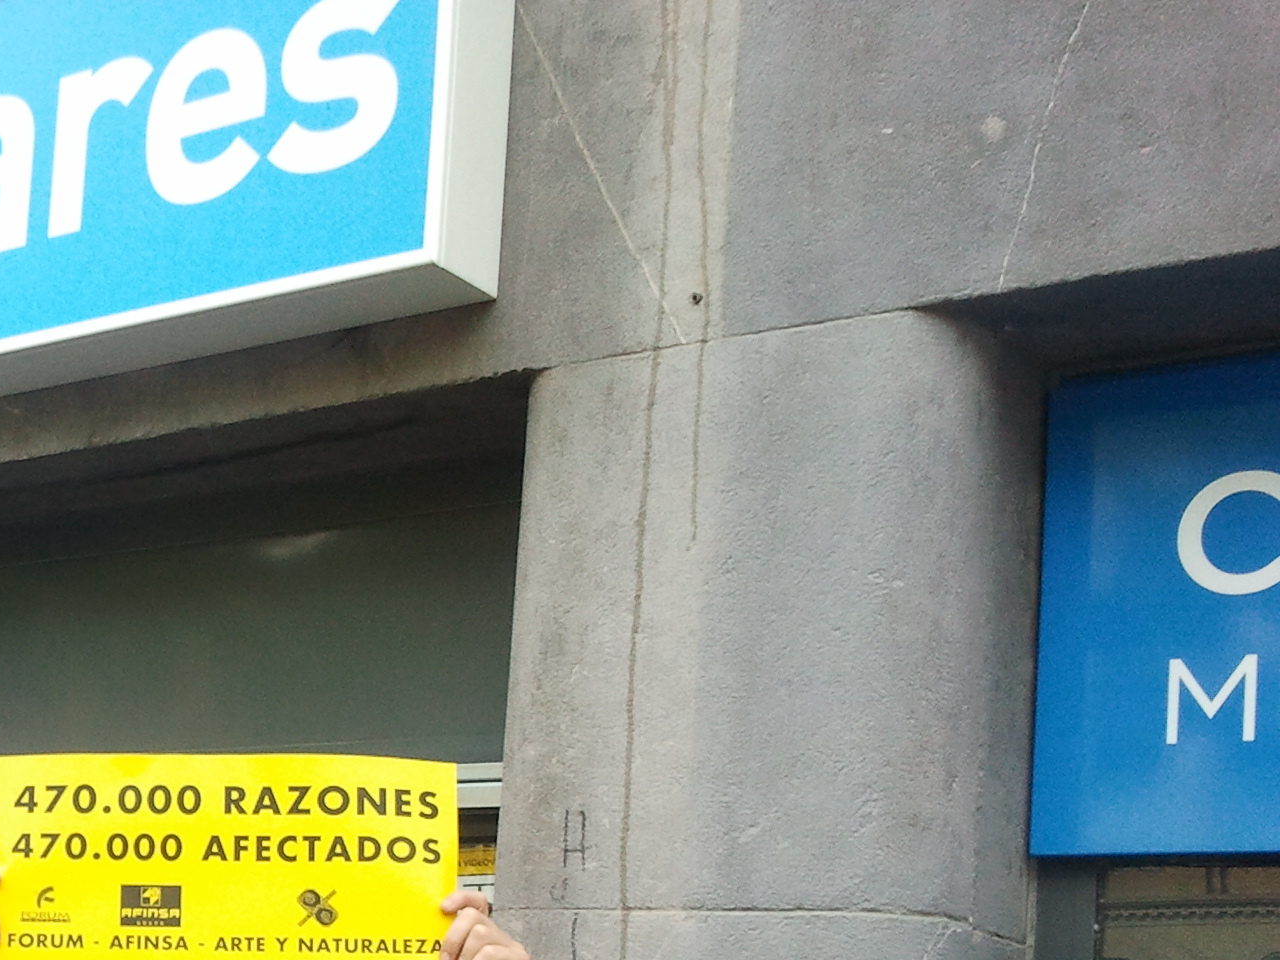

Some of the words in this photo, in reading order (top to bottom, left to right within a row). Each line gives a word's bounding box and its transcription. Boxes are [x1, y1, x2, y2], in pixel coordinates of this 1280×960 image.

[1166, 654, 1258, 745] M
[14, 784, 201, 815] 470.000
[224, 785, 439, 819] RAZONES
[11, 833, 183, 862] 470.000
[201, 835, 441, 864] AFECTADOS
[7, 932, 84, 949] FORUM
[109, 935, 189, 951] AFINSA
[214, 937, 265, 952] ARTE
[276, 937, 288, 952] Y
[298, 937, 442, 954] NATURALEZA
